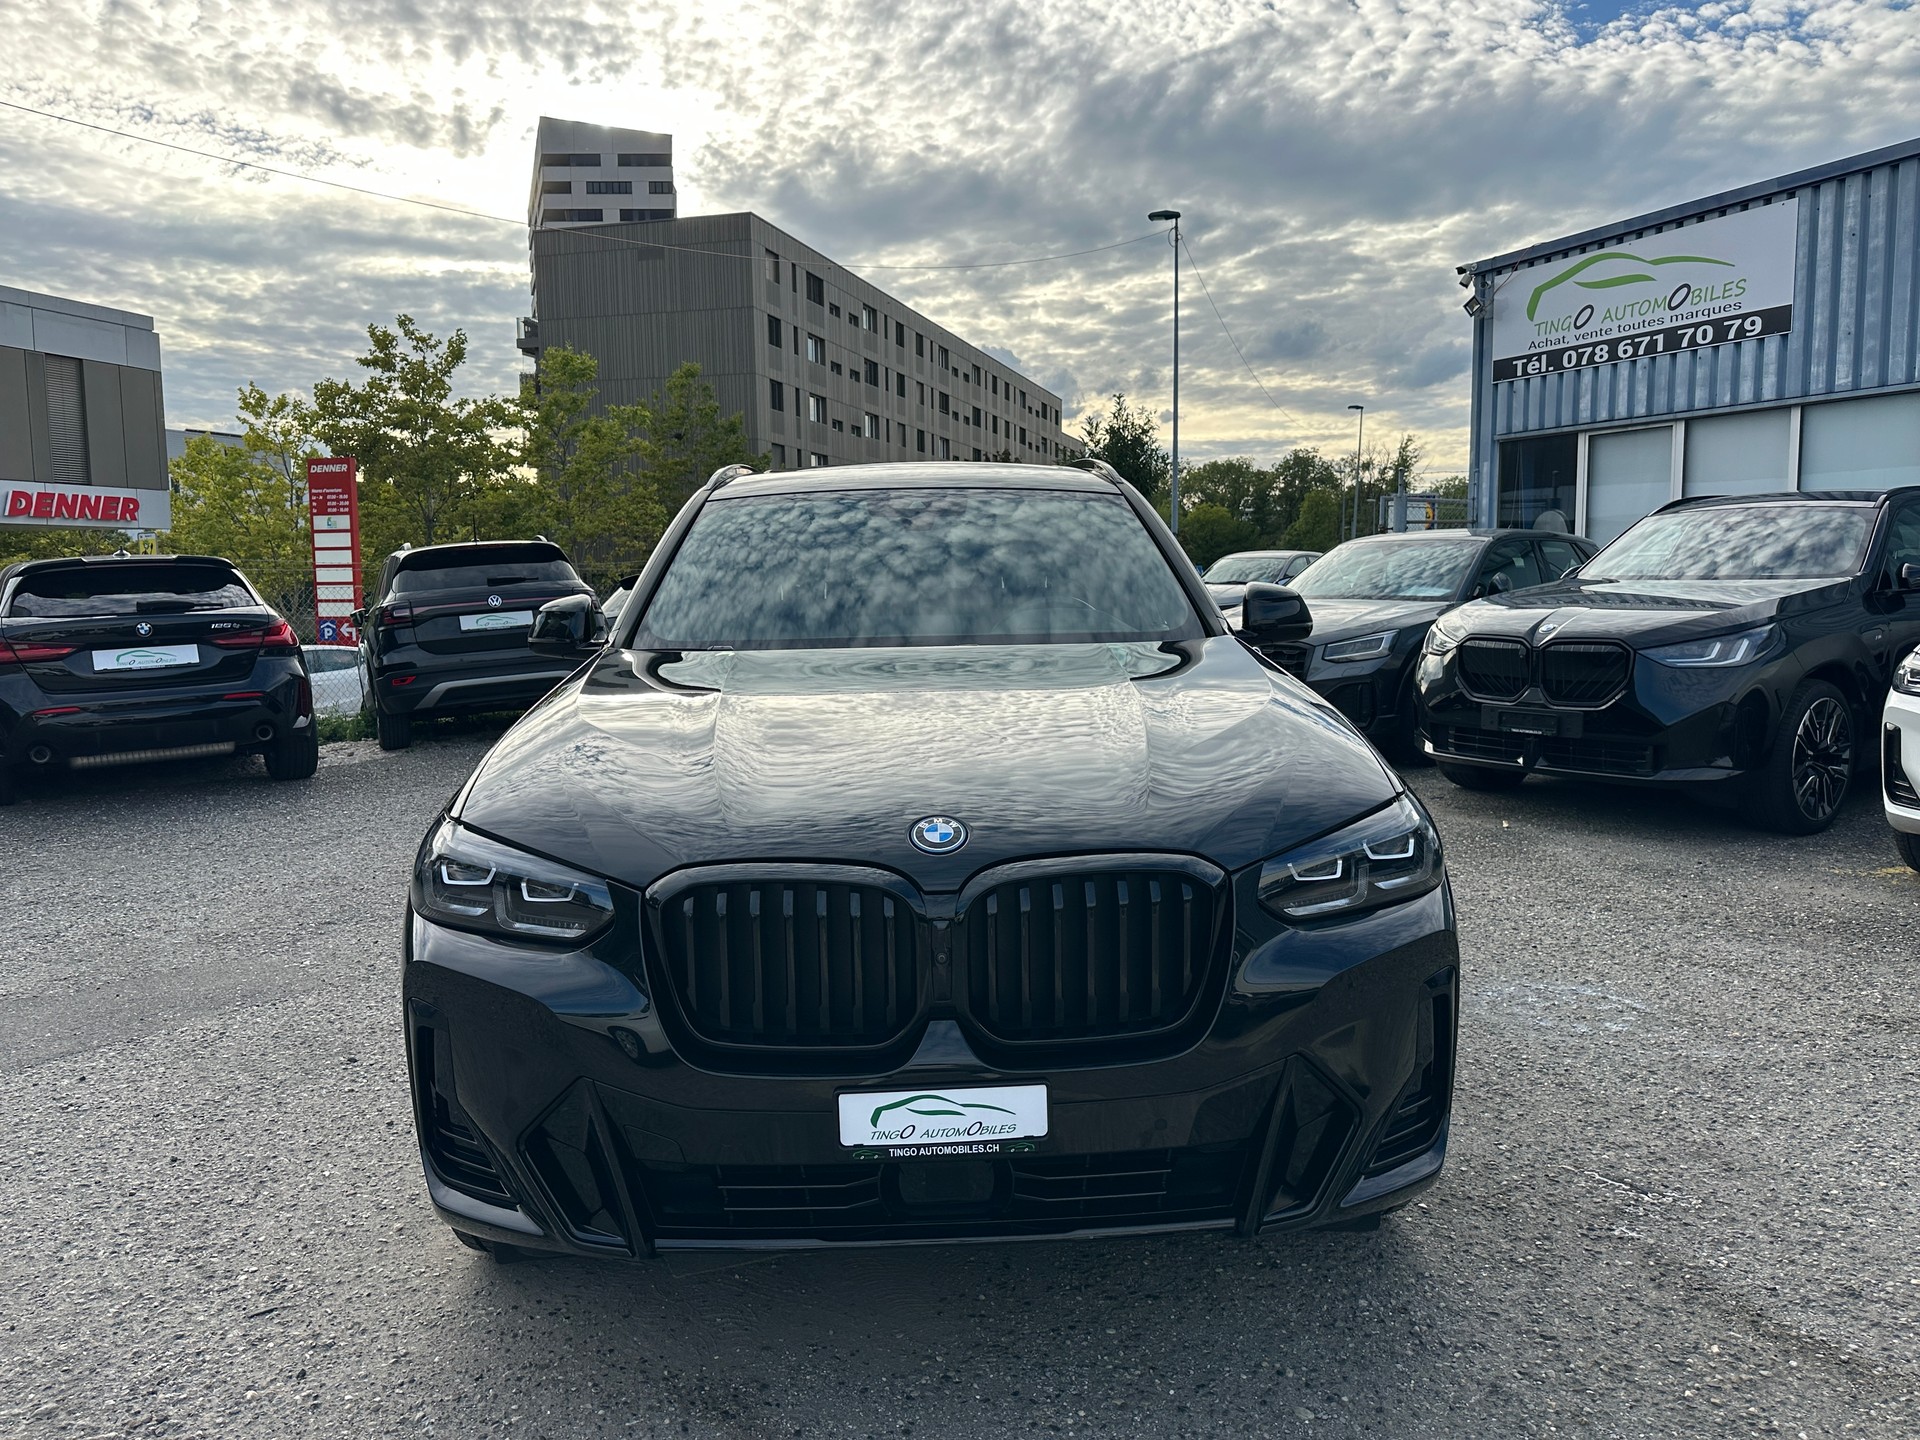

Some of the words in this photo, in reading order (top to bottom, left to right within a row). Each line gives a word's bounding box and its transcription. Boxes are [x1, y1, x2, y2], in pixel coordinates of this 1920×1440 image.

[1534, 304, 1594, 336] TINGO
[1601, 278, 1747, 324] AUTOMOBILES
[1528, 333, 1571, 351] Achat,
[1574, 326, 1613, 343] vente
[1617, 317, 1665, 333] toutes
[1670, 301, 1743, 324] marques
[1512, 354, 1554, 377] Tél.
[1562, 344, 1609, 368] 078
[1617, 333, 1664, 358] 671
[1677, 324, 1714, 348] 70
[1723, 315, 1763, 340] 79
[310, 464, 348, 473] DENNER
[4, 490, 140, 522] DENNER
[324, 628, 332, 639] P
[870, 1124, 916, 1141] TINGO
[919, 1121, 1016, 1139] AUTOMOBILES
[889, 1147, 917, 1158] TINGO
[919, 1143, 999, 1157] AUTOMOBILES.CH
